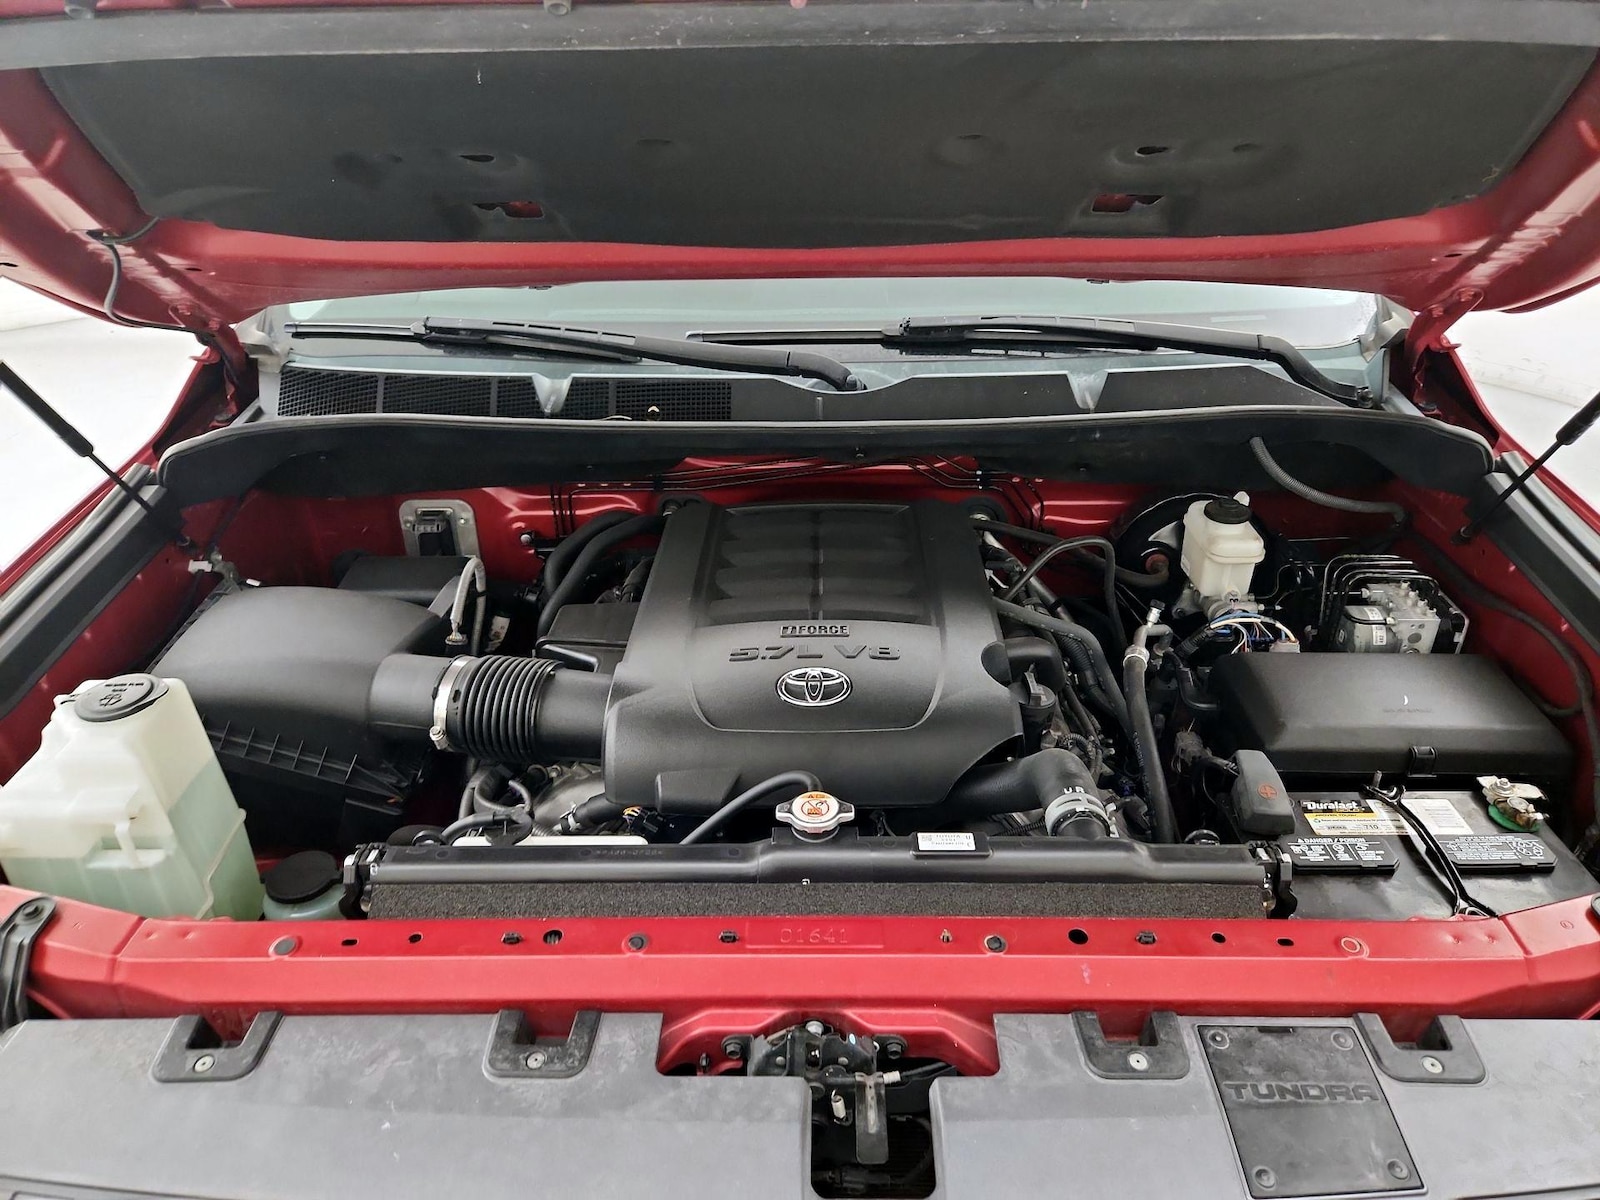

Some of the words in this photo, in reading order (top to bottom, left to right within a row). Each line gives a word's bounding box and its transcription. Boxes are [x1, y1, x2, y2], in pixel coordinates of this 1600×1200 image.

[1303, 801, 1359, 810] Duralast
[780, 928, 848, 943] 01641
[1223, 1083, 1379, 1101] TUNDRA
